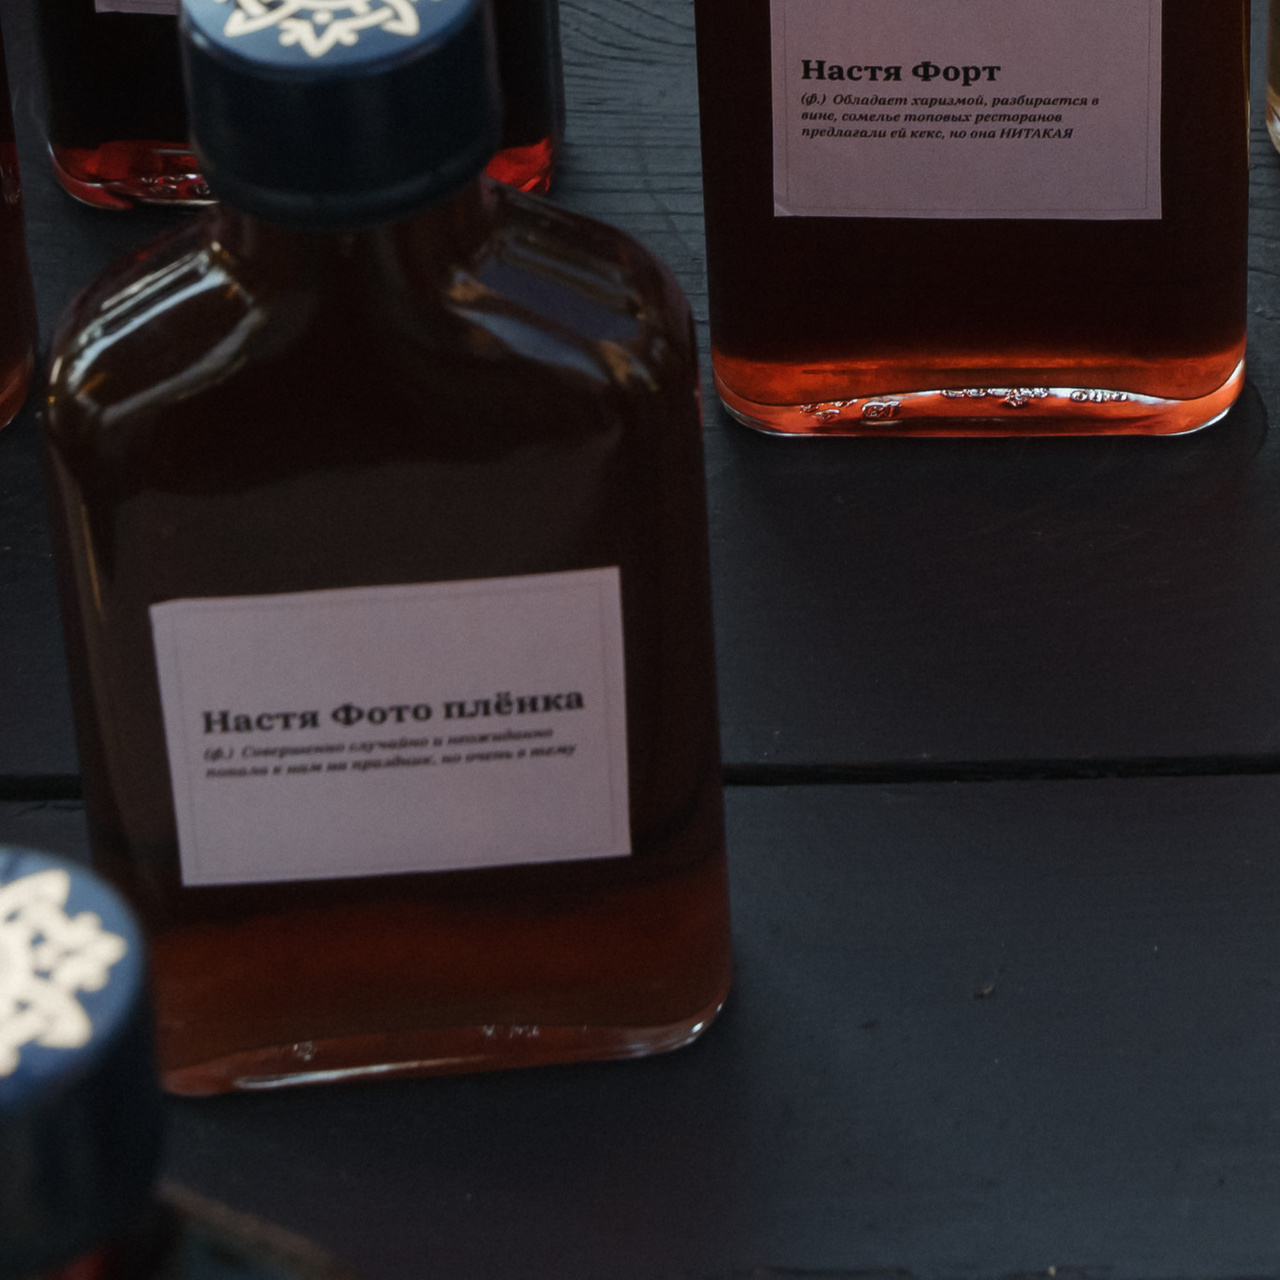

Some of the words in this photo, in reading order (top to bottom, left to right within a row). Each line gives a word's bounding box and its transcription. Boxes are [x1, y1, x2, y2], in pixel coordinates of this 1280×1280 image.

[801, 59, 903, 82] Настя
[911, 60, 1002, 87] Форт
[800, 92, 827, 107] (ф.)
[832, 93, 908, 106] Обладает
[910, 94, 988, 109] харизмой,
[991, 94, 1088, 109] разбирается
[1091, 97, 1100, 106] в
[800, 111, 838, 123] вине,
[841, 113, 901, 123] сомелье
[903, 113, 972, 123] топовых
[973, 113, 1063, 125] ресторанов
[801, 126, 887, 139] предлагали
[889, 127, 907, 139] ей
[910, 130, 945, 140] кекс,
[949, 130, 967, 139] но
[969, 130, 996, 139] она
[999, 127, 1074, 139] НИТАКАЯ
[202, 710, 320, 734] Настя
[330, 703, 433, 727] Фото
[443, 691, 585, 720] плёнка
[347, 736, 430, 754] случайно
[432, 736, 444, 748] и
[440, 753, 463, 765] но
